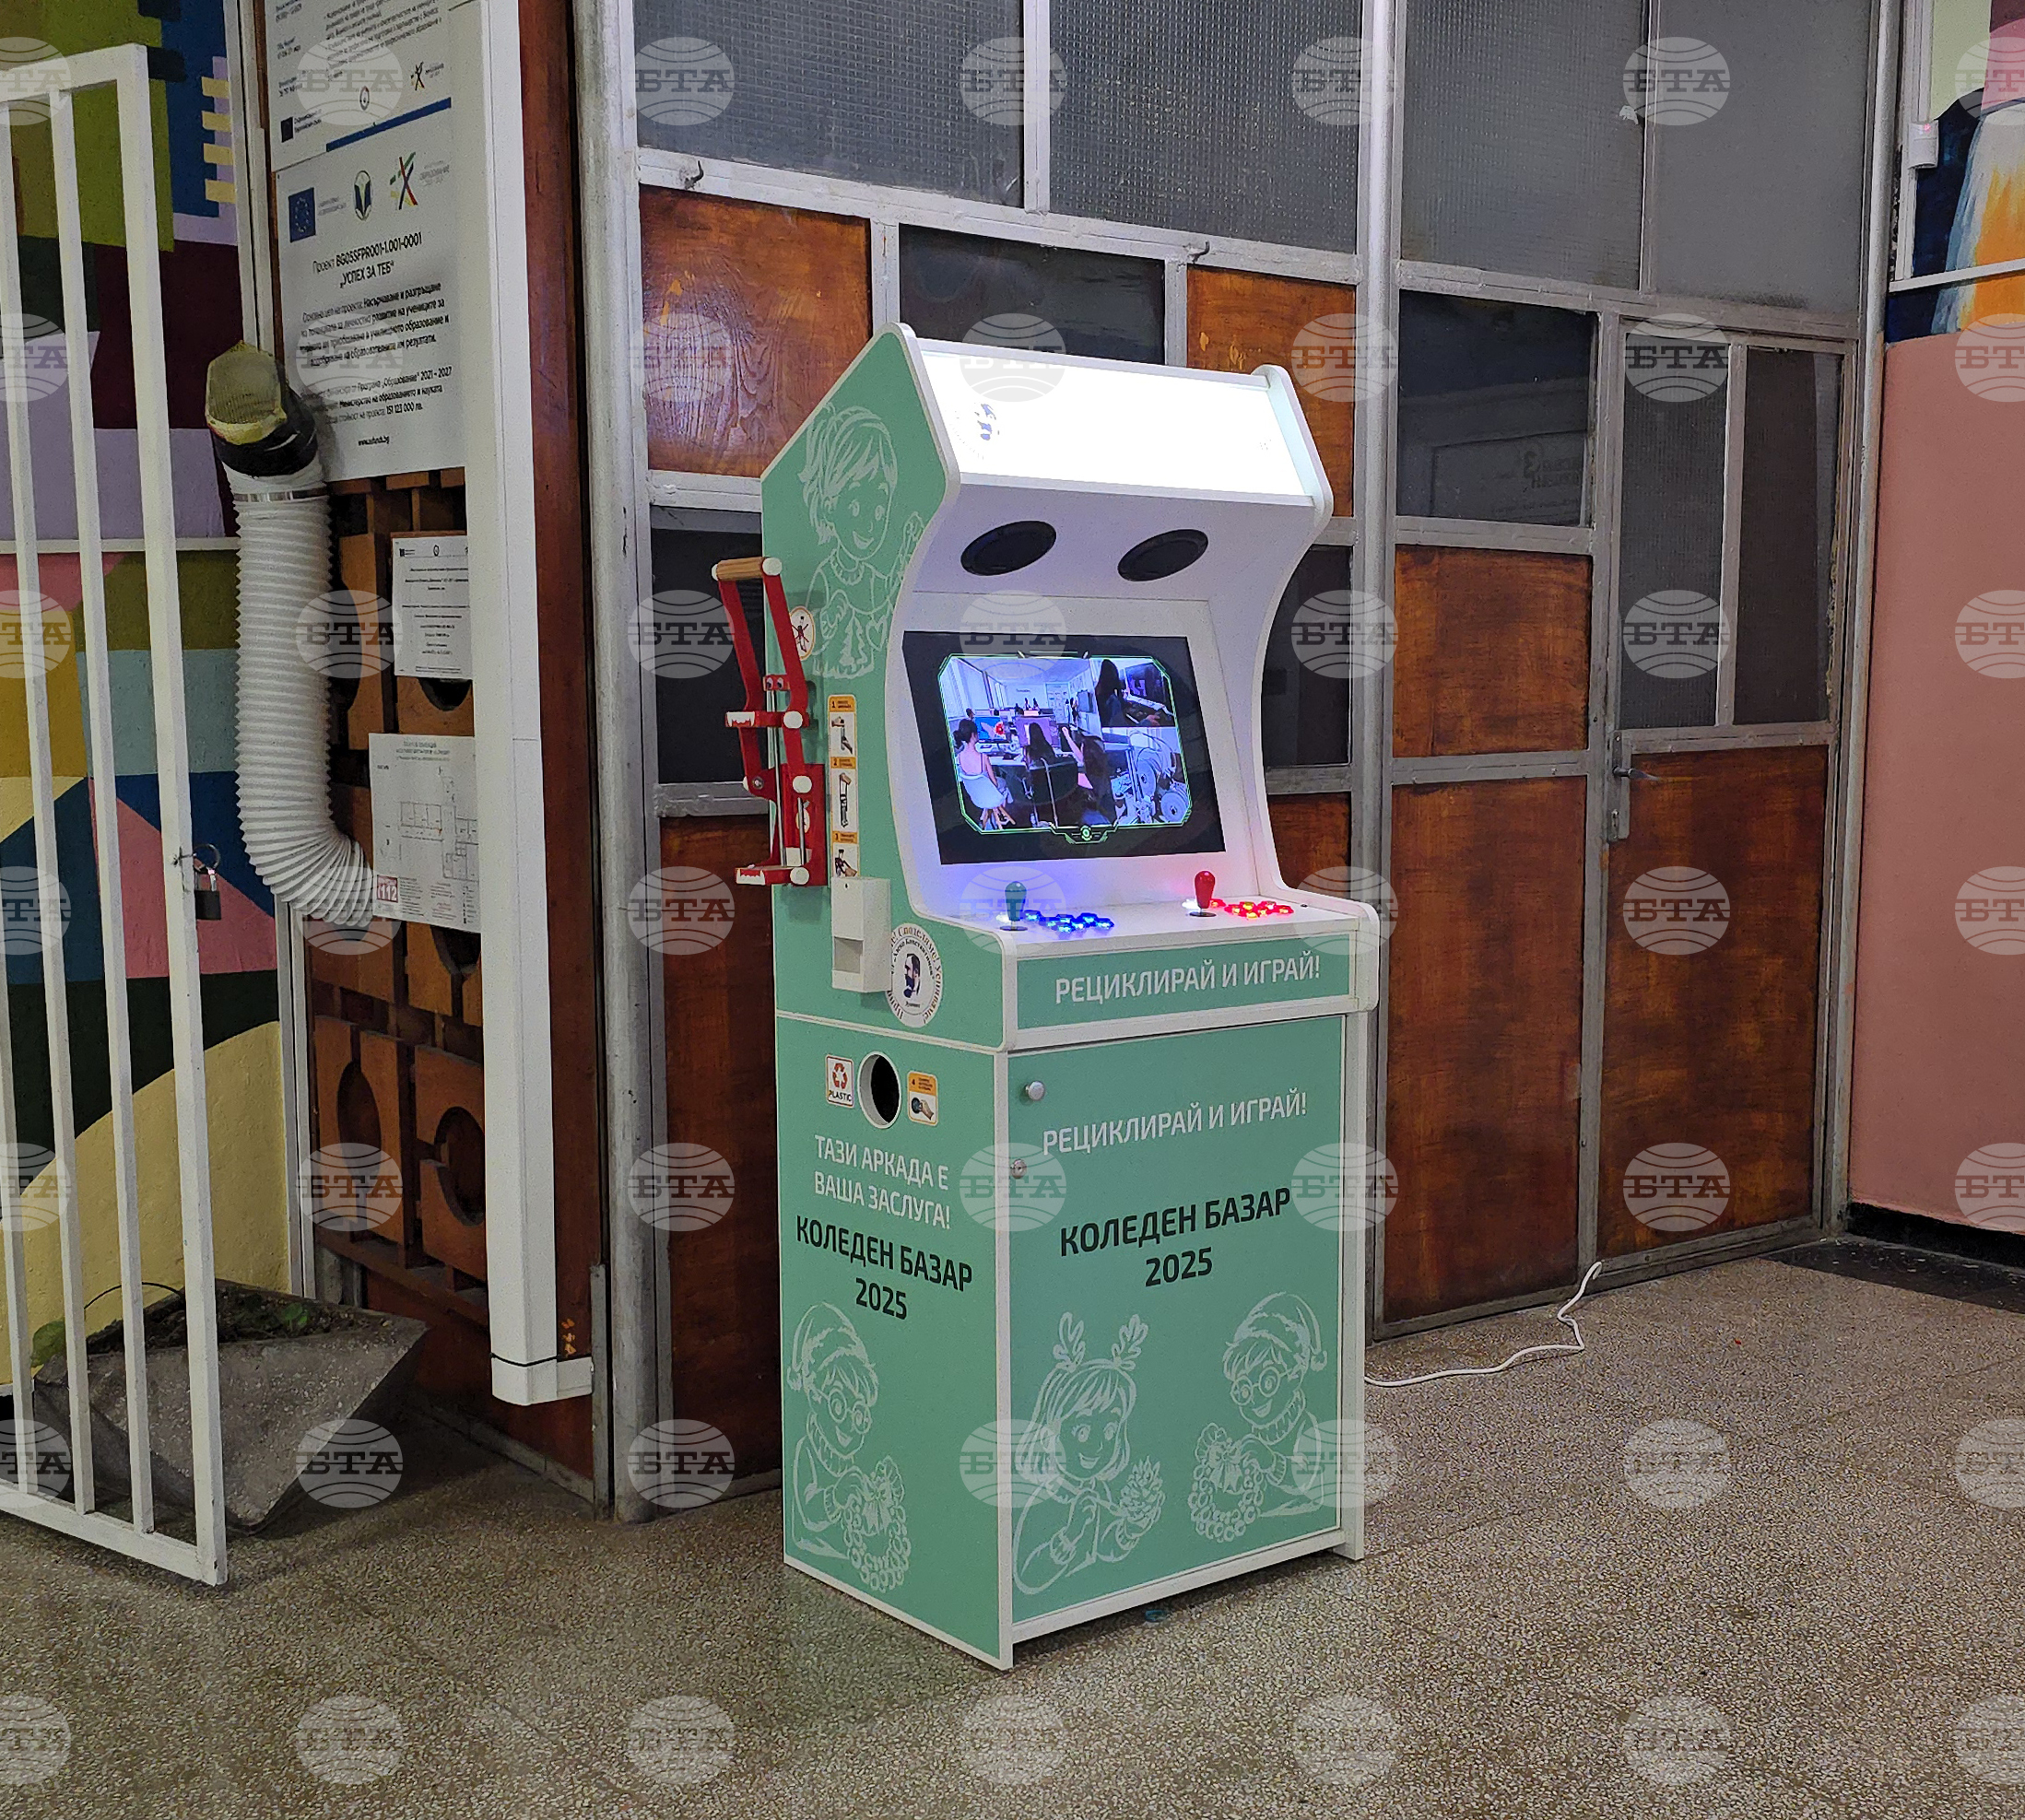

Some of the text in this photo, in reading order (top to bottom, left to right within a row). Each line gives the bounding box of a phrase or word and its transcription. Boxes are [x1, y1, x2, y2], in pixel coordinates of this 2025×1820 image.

[365, 264, 377, 279] ЗА
[1055, 950, 1321, 1004] РЕЦИКЛИРАЙ И ИГРАЙ!
[829, 1089, 853, 1102] PLASTIC
[1042, 1087, 1307, 1156] РЕЦИКЛИРАЙ И ИГРАЙ!
[815, 1134, 949, 1191] ТАЗИ АРКАДА Е
[815, 1171, 950, 1230] ВАША ЗАСЛУГА!
[1060, 1187, 1291, 1257] КОЛЕДЕН БАЗАР
[796, 1215, 973, 1292] КОЛЕДЕН БАЗАР
[1145, 1247, 1213, 1287] 2025
[855, 1277, 907, 1321] 2025
